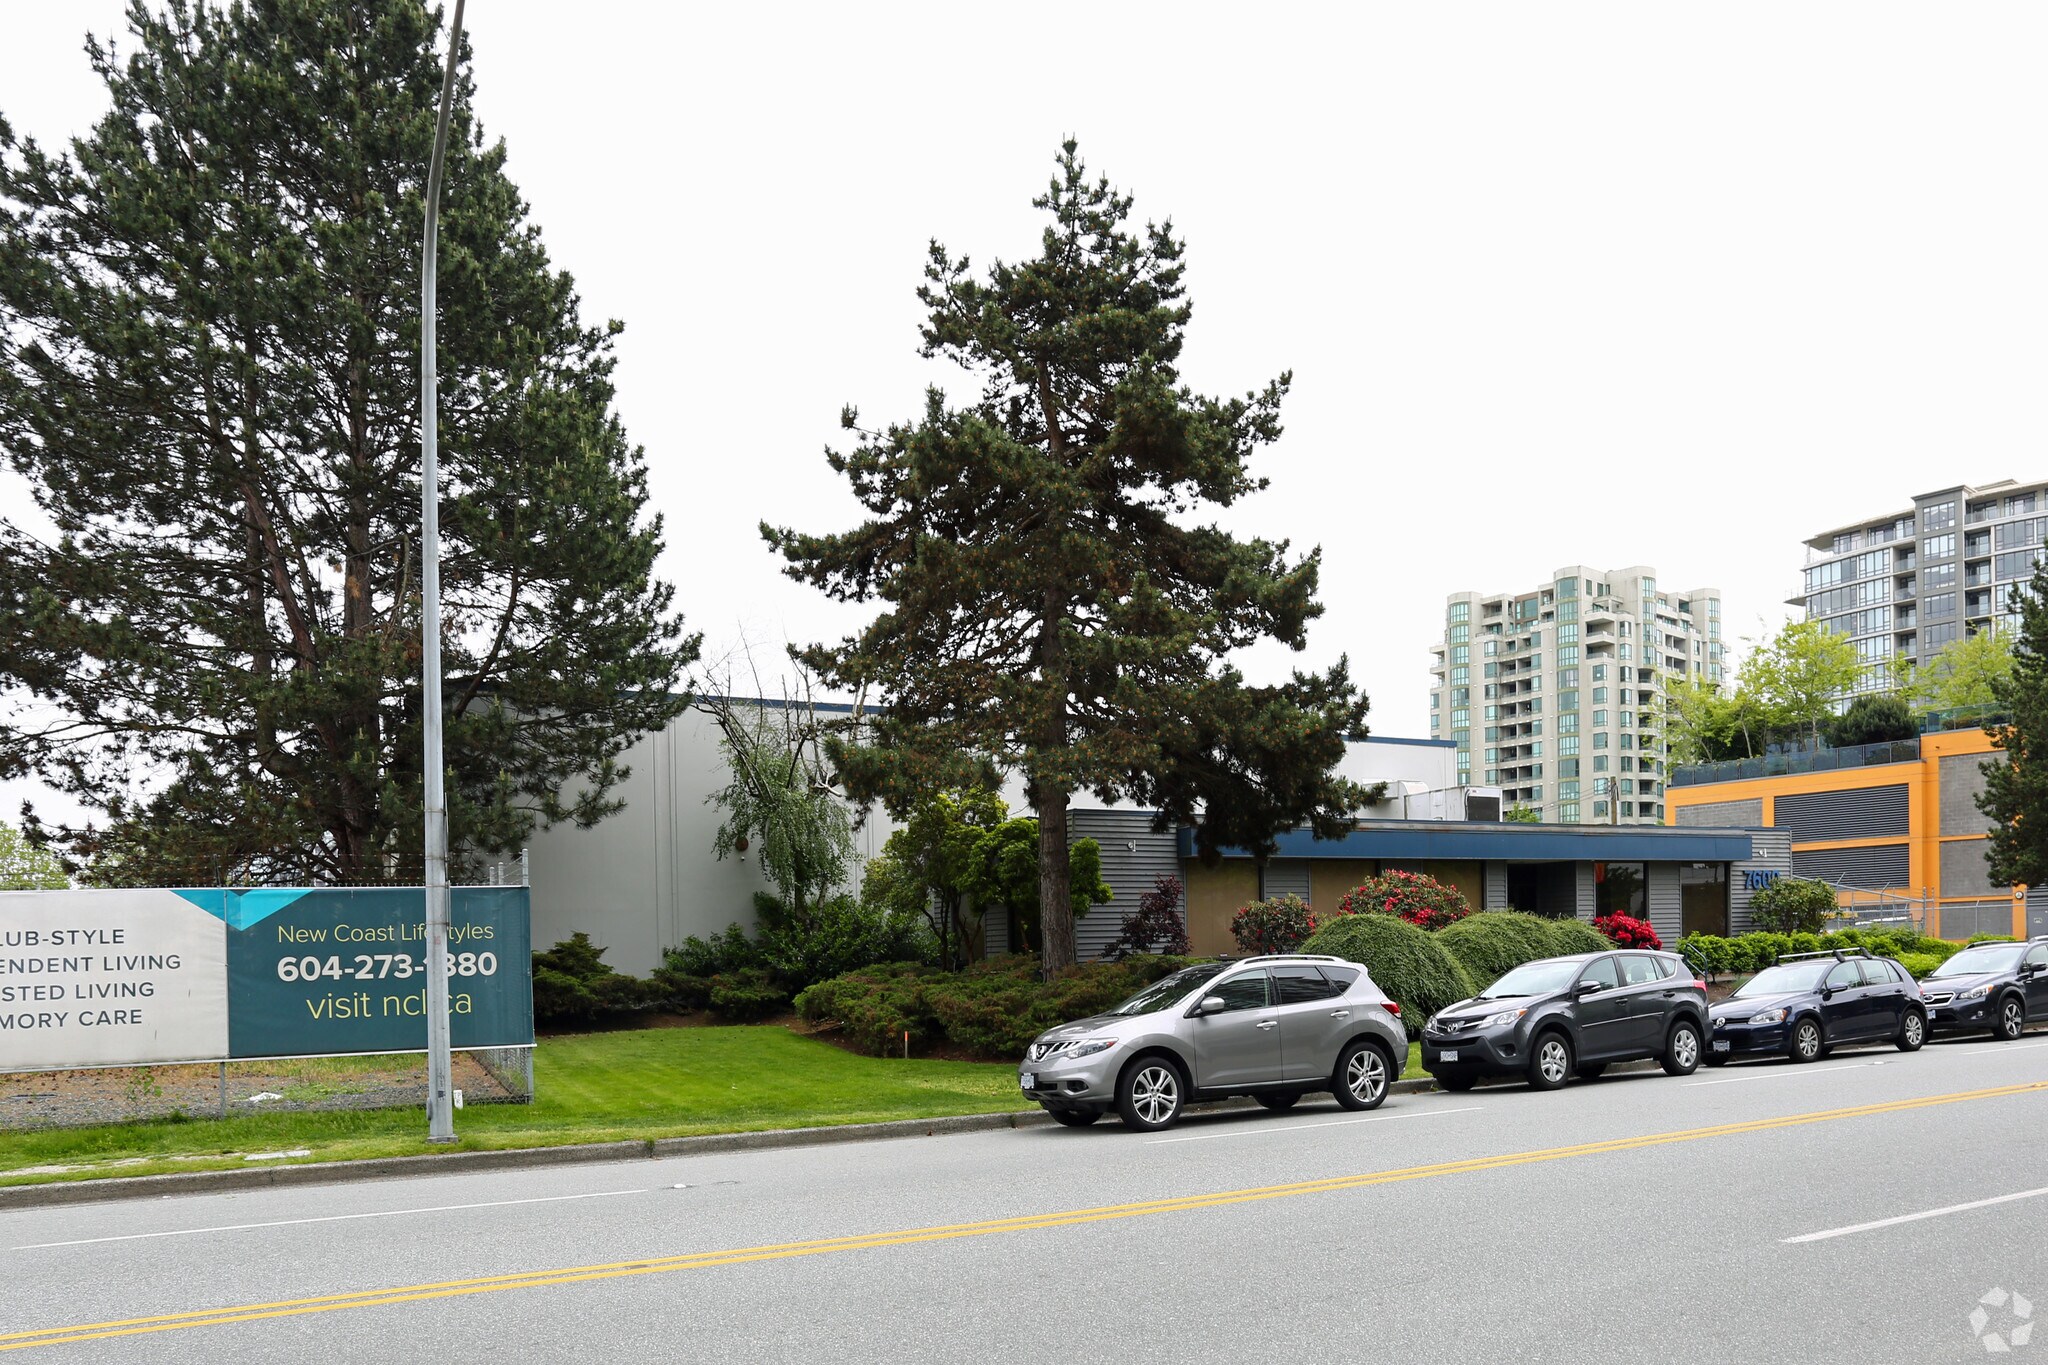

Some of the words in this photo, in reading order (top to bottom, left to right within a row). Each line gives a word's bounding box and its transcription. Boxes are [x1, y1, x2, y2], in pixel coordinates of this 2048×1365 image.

[0, 929, 125, 947] UB-STYLE
[278, 925, 327, 943] New
[334, 924, 395, 942] Coast
[103, 954, 181, 971] LIVING
[75, 982, 155, 999] LIVING
[306, 991, 372, 1019] visit
[0, 1011, 69, 1029] MORY
[78, 1009, 142, 1026] CARE
